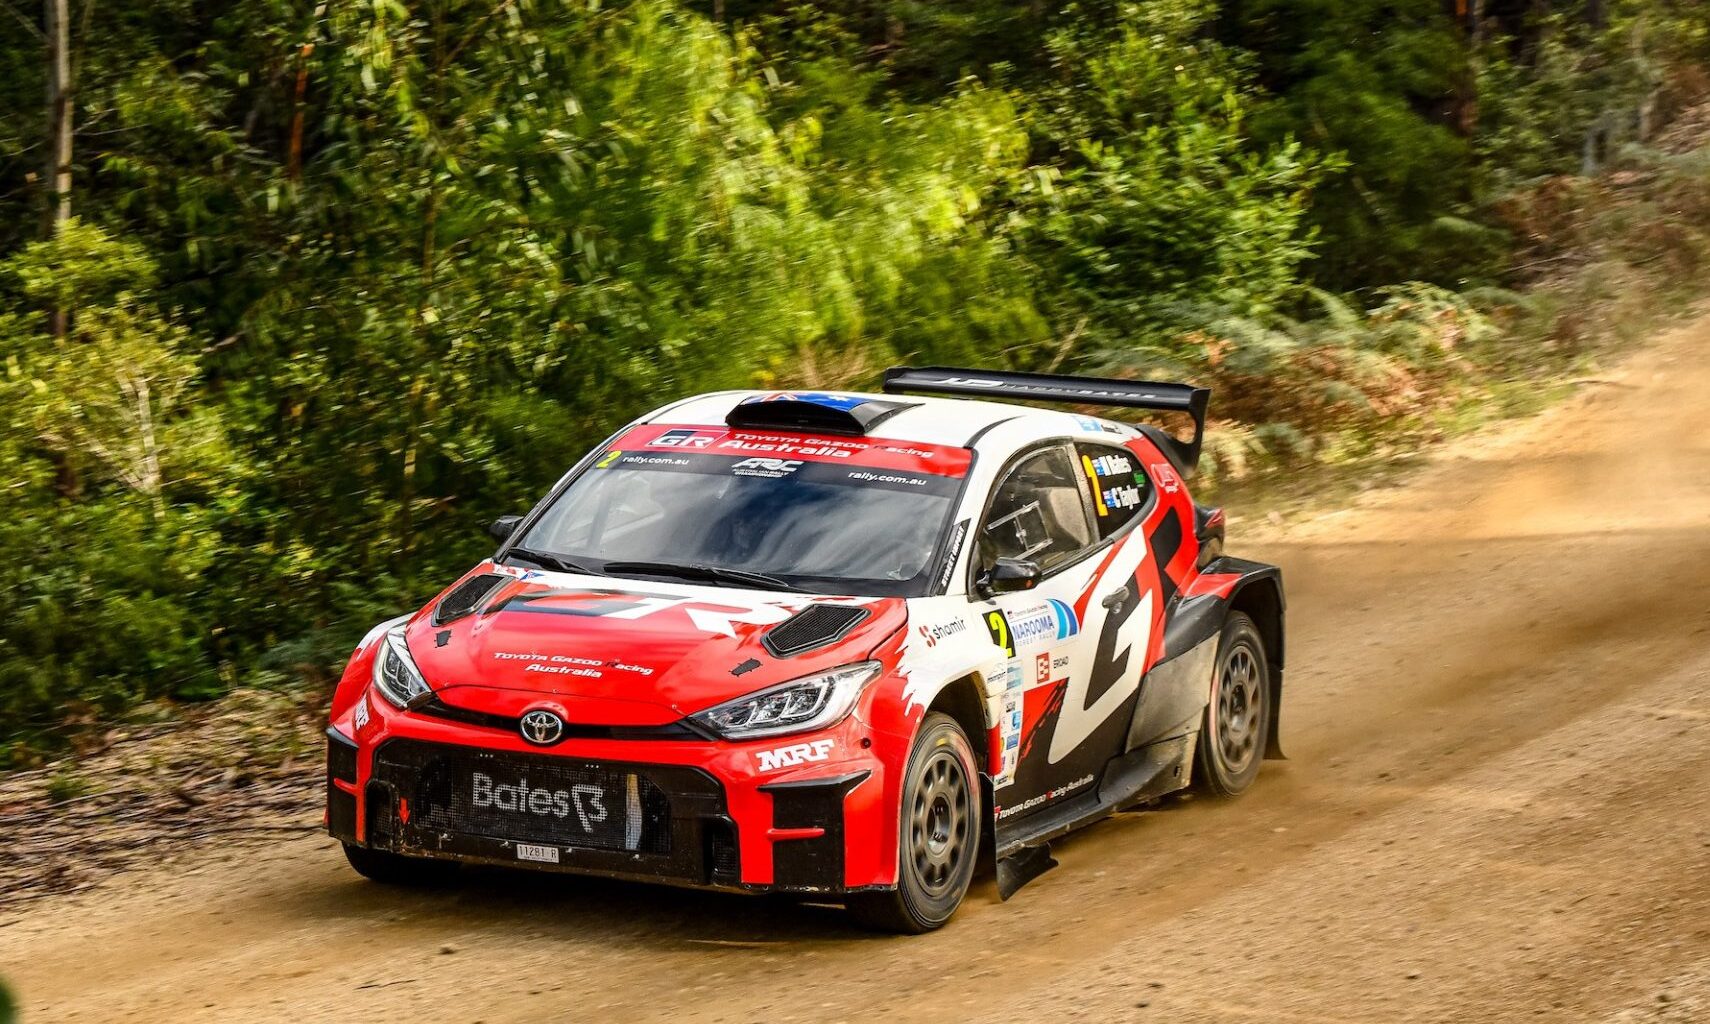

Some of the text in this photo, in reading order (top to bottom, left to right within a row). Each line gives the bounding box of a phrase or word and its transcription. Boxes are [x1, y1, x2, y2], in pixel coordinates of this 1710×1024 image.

[649, 435, 714, 448] GR
[718, 439, 851, 458] Australia
[733, 433, 935, 459] TOYOTA GAZOO Racing
[596, 450, 622, 469] 2
[622, 456, 690, 466] rally.com.au
[848, 472, 927, 486] rally.com.au
[933, 617, 967, 640] shamir
[988, 611, 1013, 658] 2
[1011, 615, 1055, 640] NAROOMA
[494, 651, 654, 676] TOYOTA GAZOO Racing
[525, 662, 603, 679] Australia
[756, 738, 835, 772] MRF
[472, 772, 570, 818] Bates
[999, 803, 1024, 820] TOYOTA
